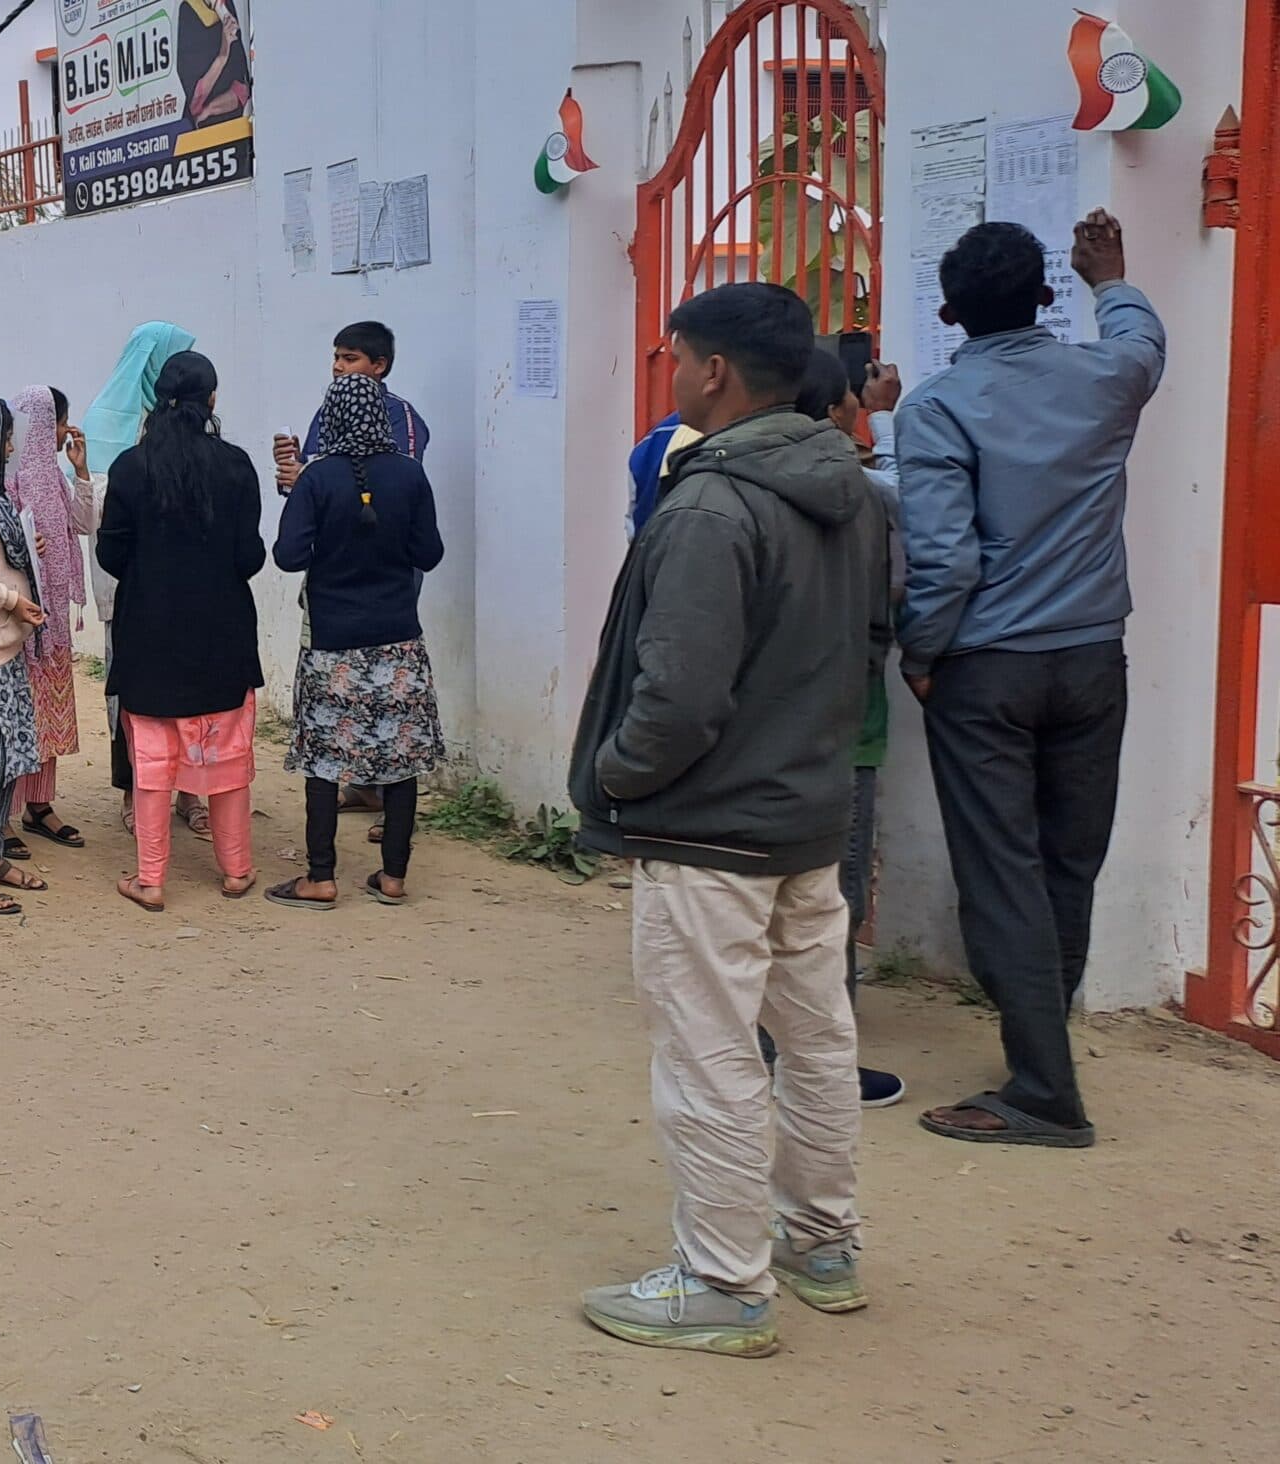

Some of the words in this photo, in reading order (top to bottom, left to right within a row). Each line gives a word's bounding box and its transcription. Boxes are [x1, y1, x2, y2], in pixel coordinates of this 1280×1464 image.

[65, 51, 110, 101] B.Lis
[117, 28, 170, 84] M.Lis
[125, 104, 140, 127] सभी
[156, 97, 163, 118] के
[163, 94, 177, 116] लिए
[79, 151, 96, 172] Kali
[97, 146, 126, 168] Sthan,
[127, 134, 169, 159] Sasaram
[91, 147, 238, 206] 8539844555
